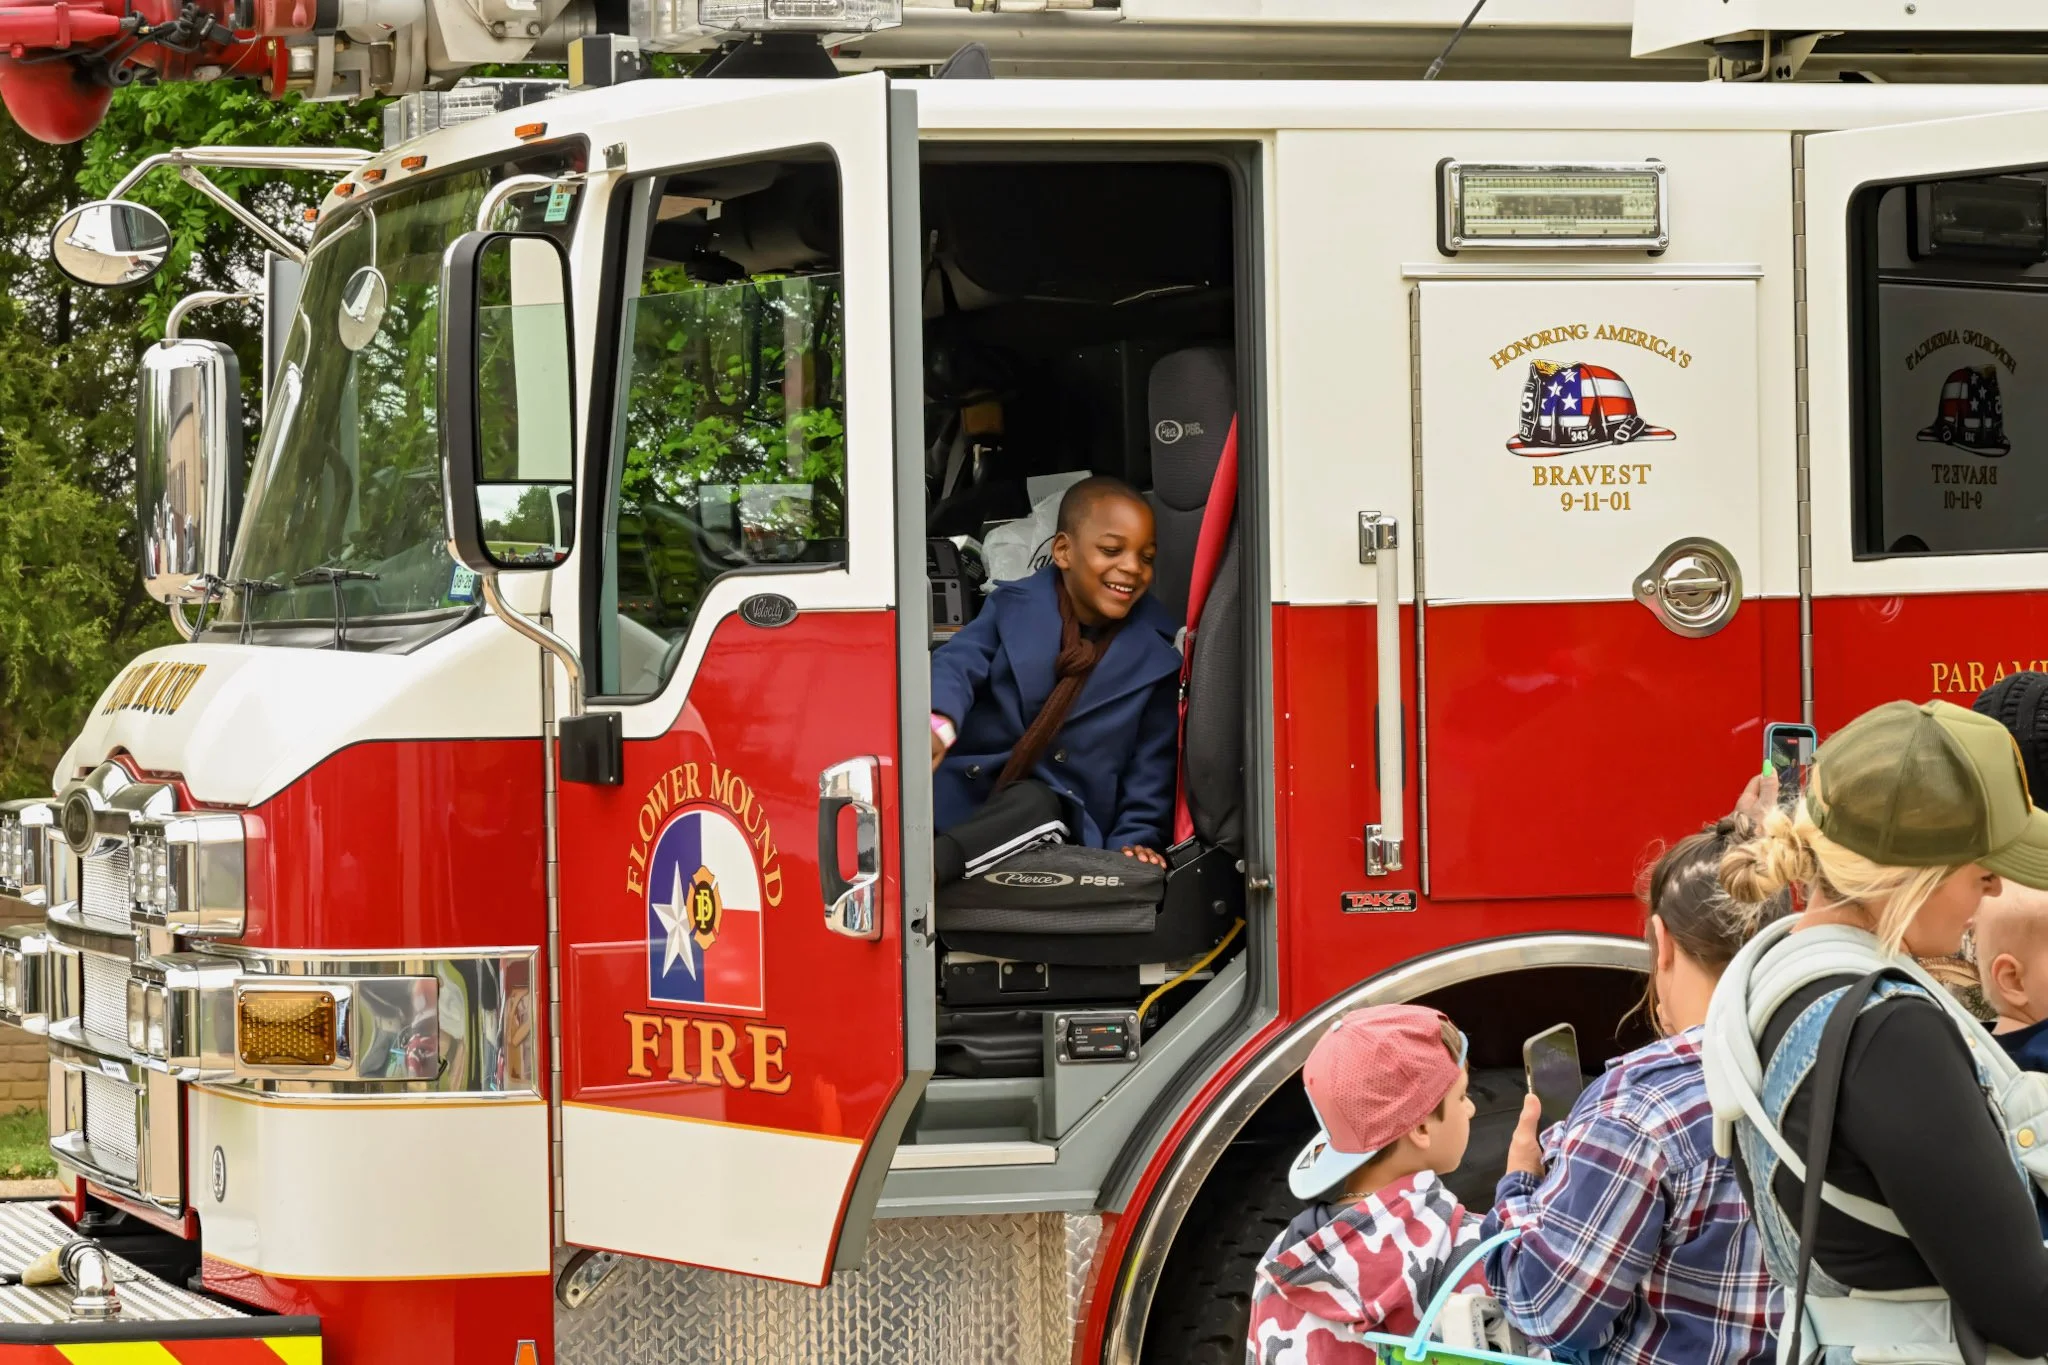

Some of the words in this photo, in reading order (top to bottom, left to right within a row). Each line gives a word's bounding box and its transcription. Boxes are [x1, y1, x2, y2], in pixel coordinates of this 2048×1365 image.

[1489, 324, 1589, 369] HONORING
[1593, 324, 1692, 369] AMERICA'S
[1571, 431, 1588, 442] 343
[1532, 464, 1652, 486] BRAVEST
[1560, 491, 1631, 512] 9-11-01
[627, 762, 702, 898] FLOWER
[709, 762, 783, 907] MOUND
[1004, 873, 1053, 884] Pierce
[1080, 875, 1119, 886] PS6
[623, 1012, 793, 1095] FIRE
